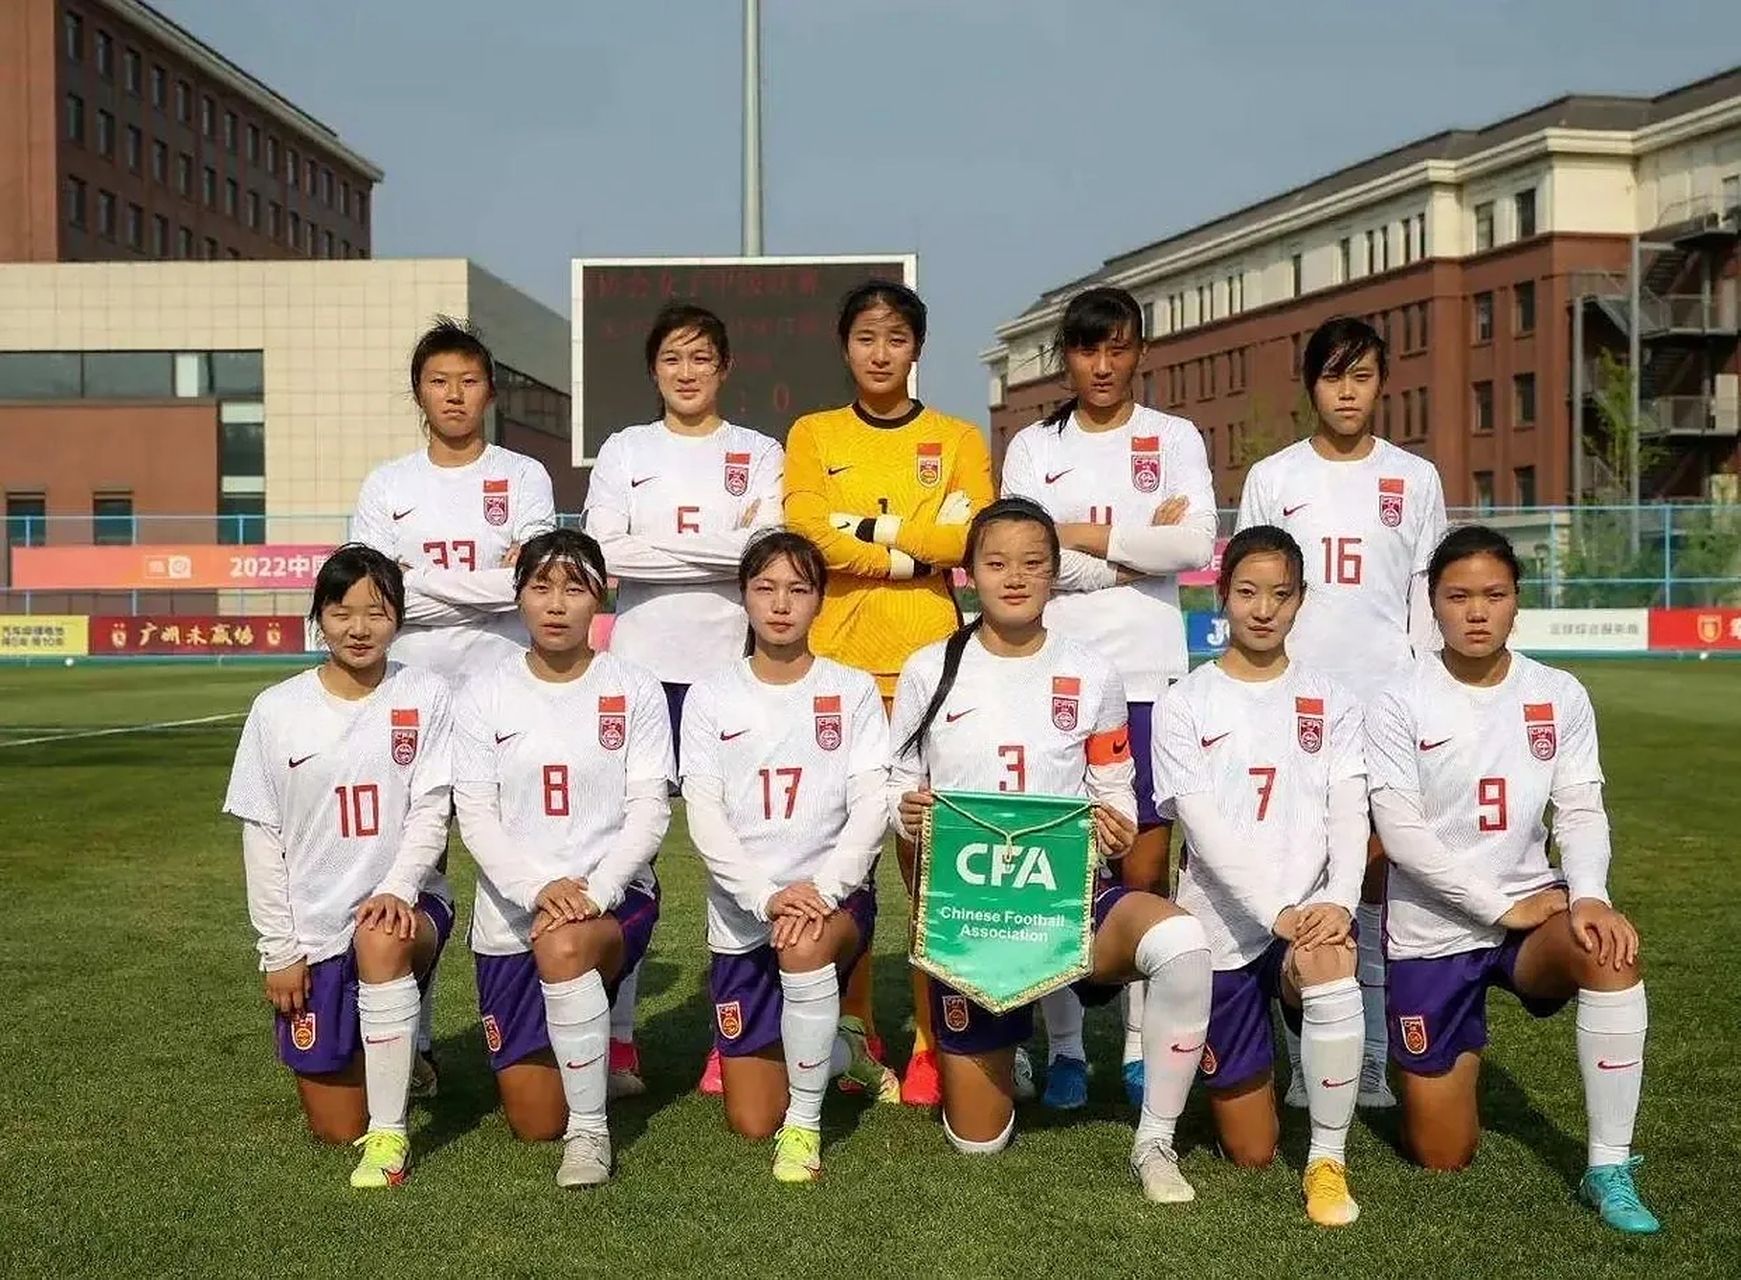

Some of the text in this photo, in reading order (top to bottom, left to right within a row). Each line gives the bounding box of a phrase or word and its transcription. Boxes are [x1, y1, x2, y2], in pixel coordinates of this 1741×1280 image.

[1322, 537, 1361, 584] 16
[543, 765, 570, 816] 8
[998, 745, 1025, 792] 3
[335, 784, 378, 838] 10
[758, 767, 802, 820] 17
[1249, 767, 1276, 821] 7
[1478, 778, 1507, 831] 9
[956, 843, 1057, 890] CFA
[940, 906, 1066, 928] Chinese Football
[960, 924, 1048, 942] Association
